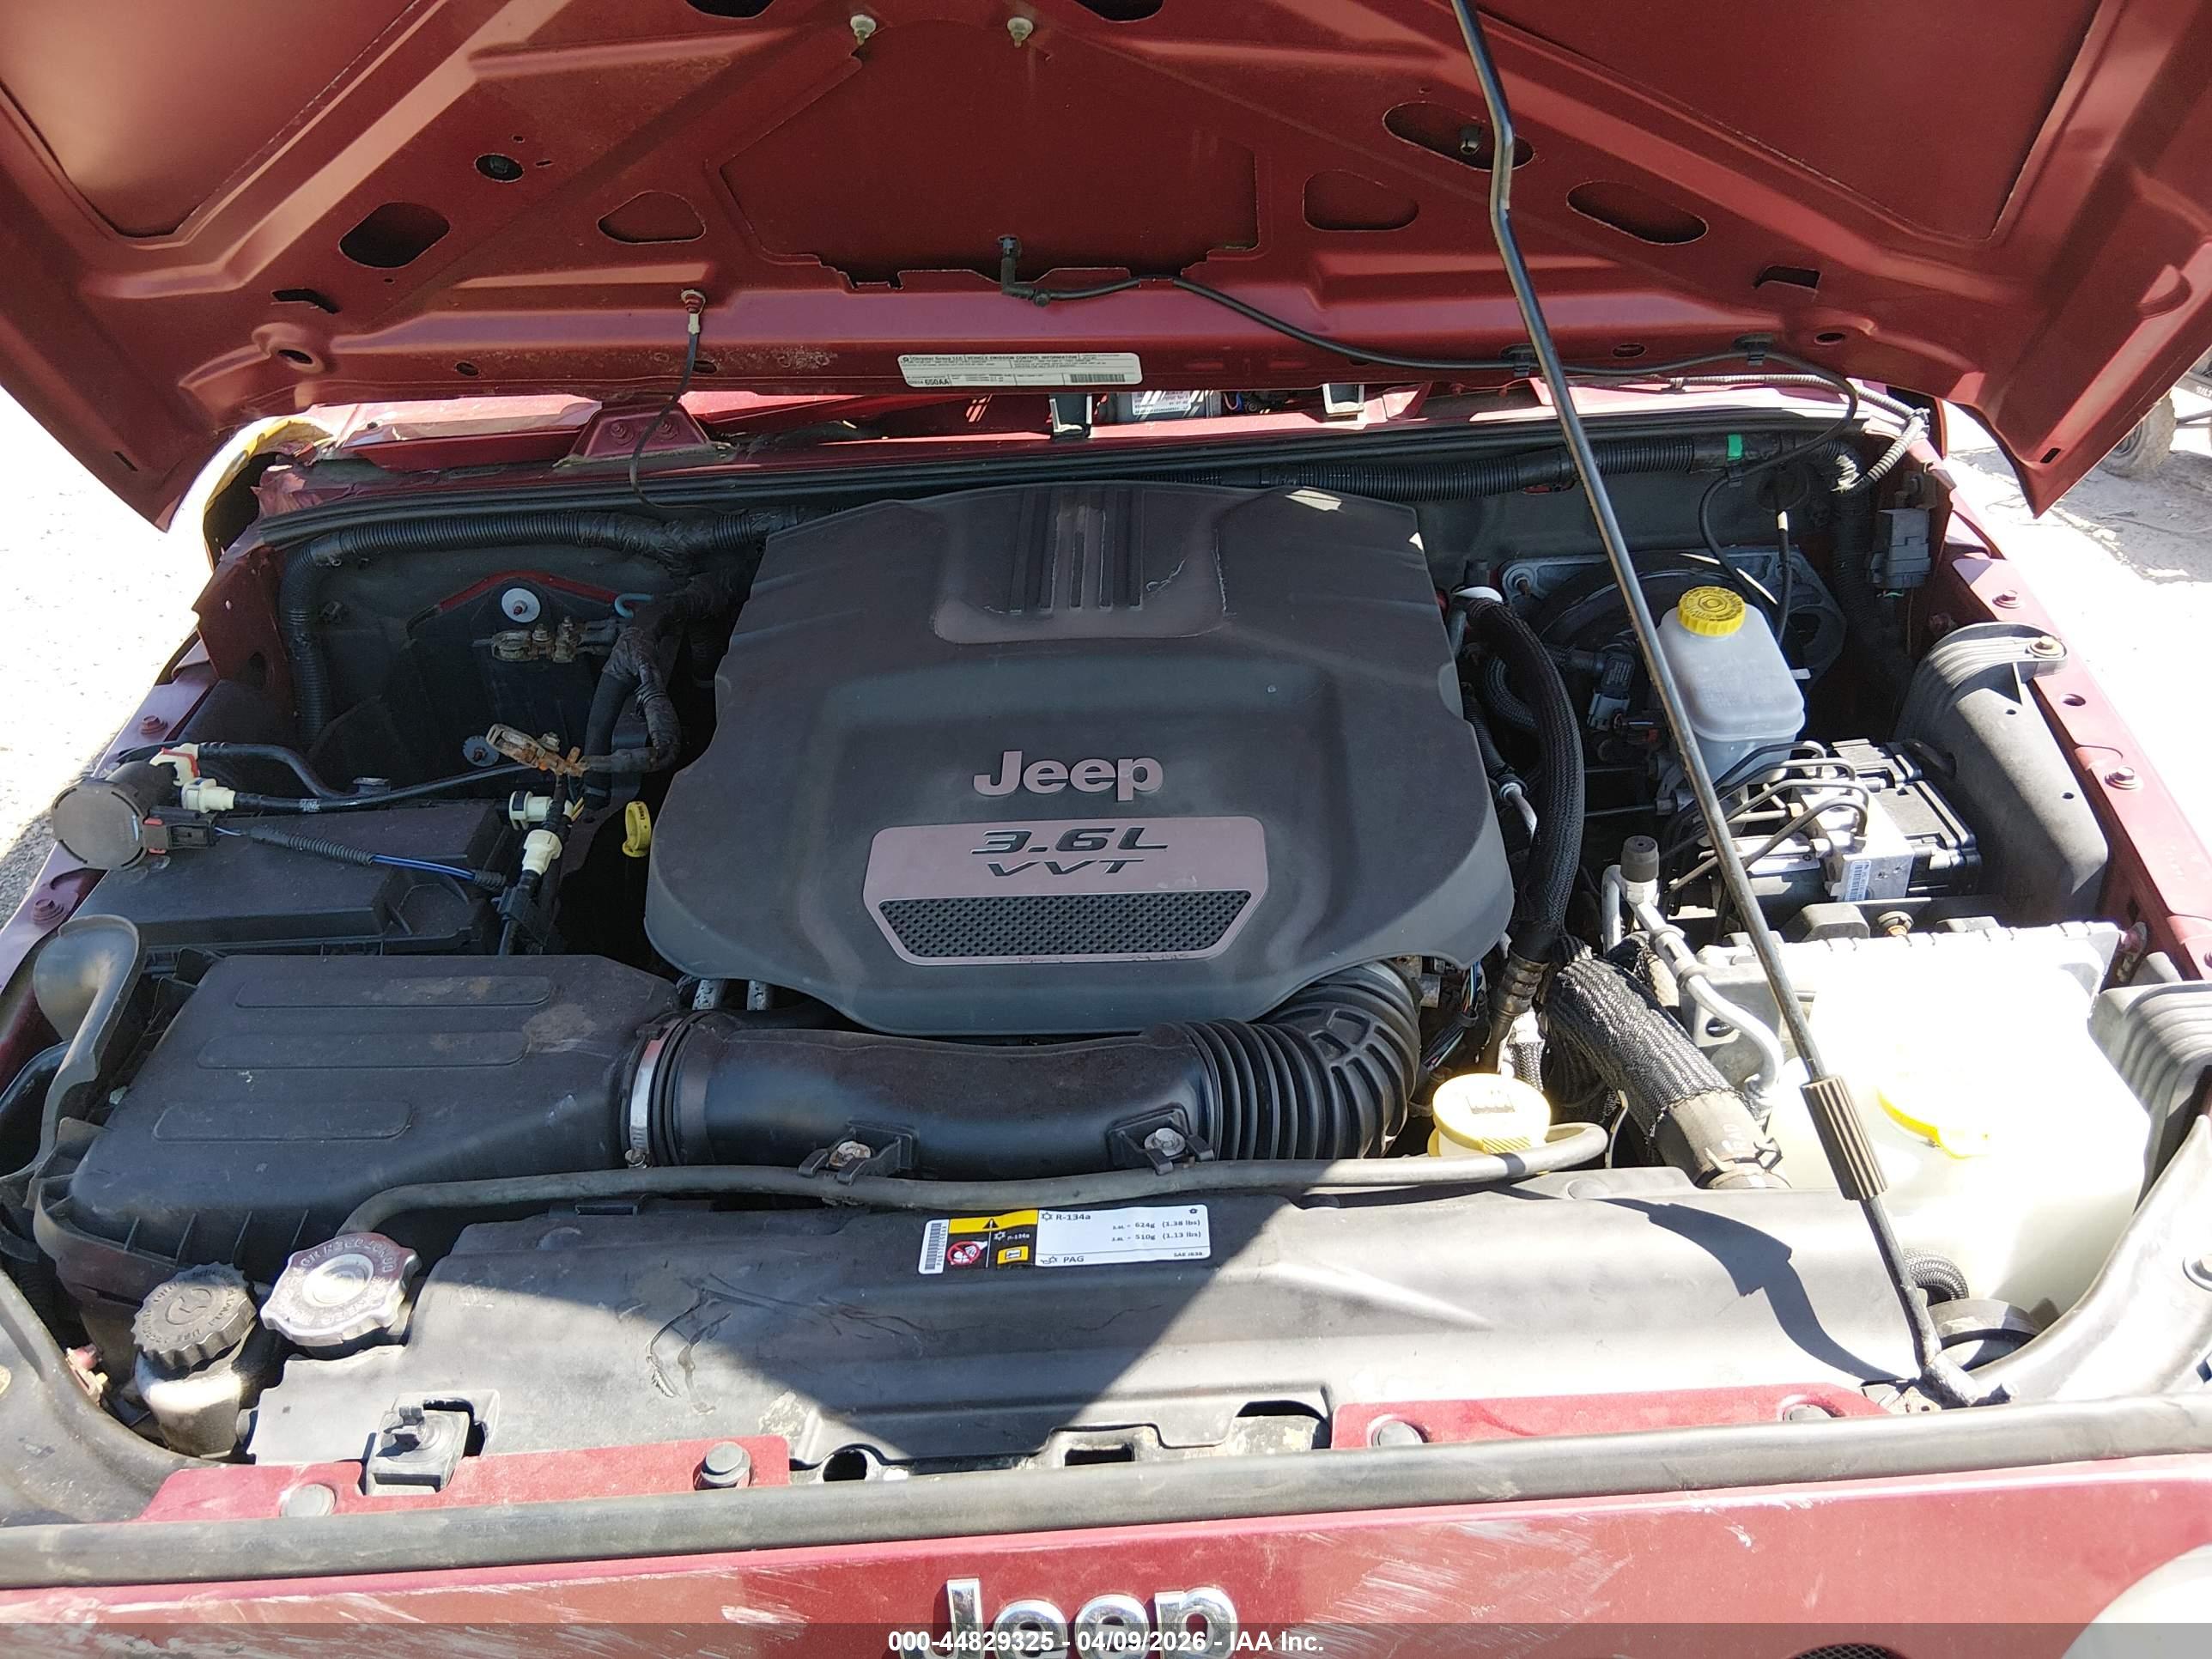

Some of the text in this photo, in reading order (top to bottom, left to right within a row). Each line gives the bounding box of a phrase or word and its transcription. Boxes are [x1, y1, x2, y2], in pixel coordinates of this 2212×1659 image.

[974, 750, 1164, 802] Jeep
[971, 827, 1169, 854] 3.6L
[988, 859, 1145, 877] VVT
[1055, 1213, 1091, 1222] R-134a
